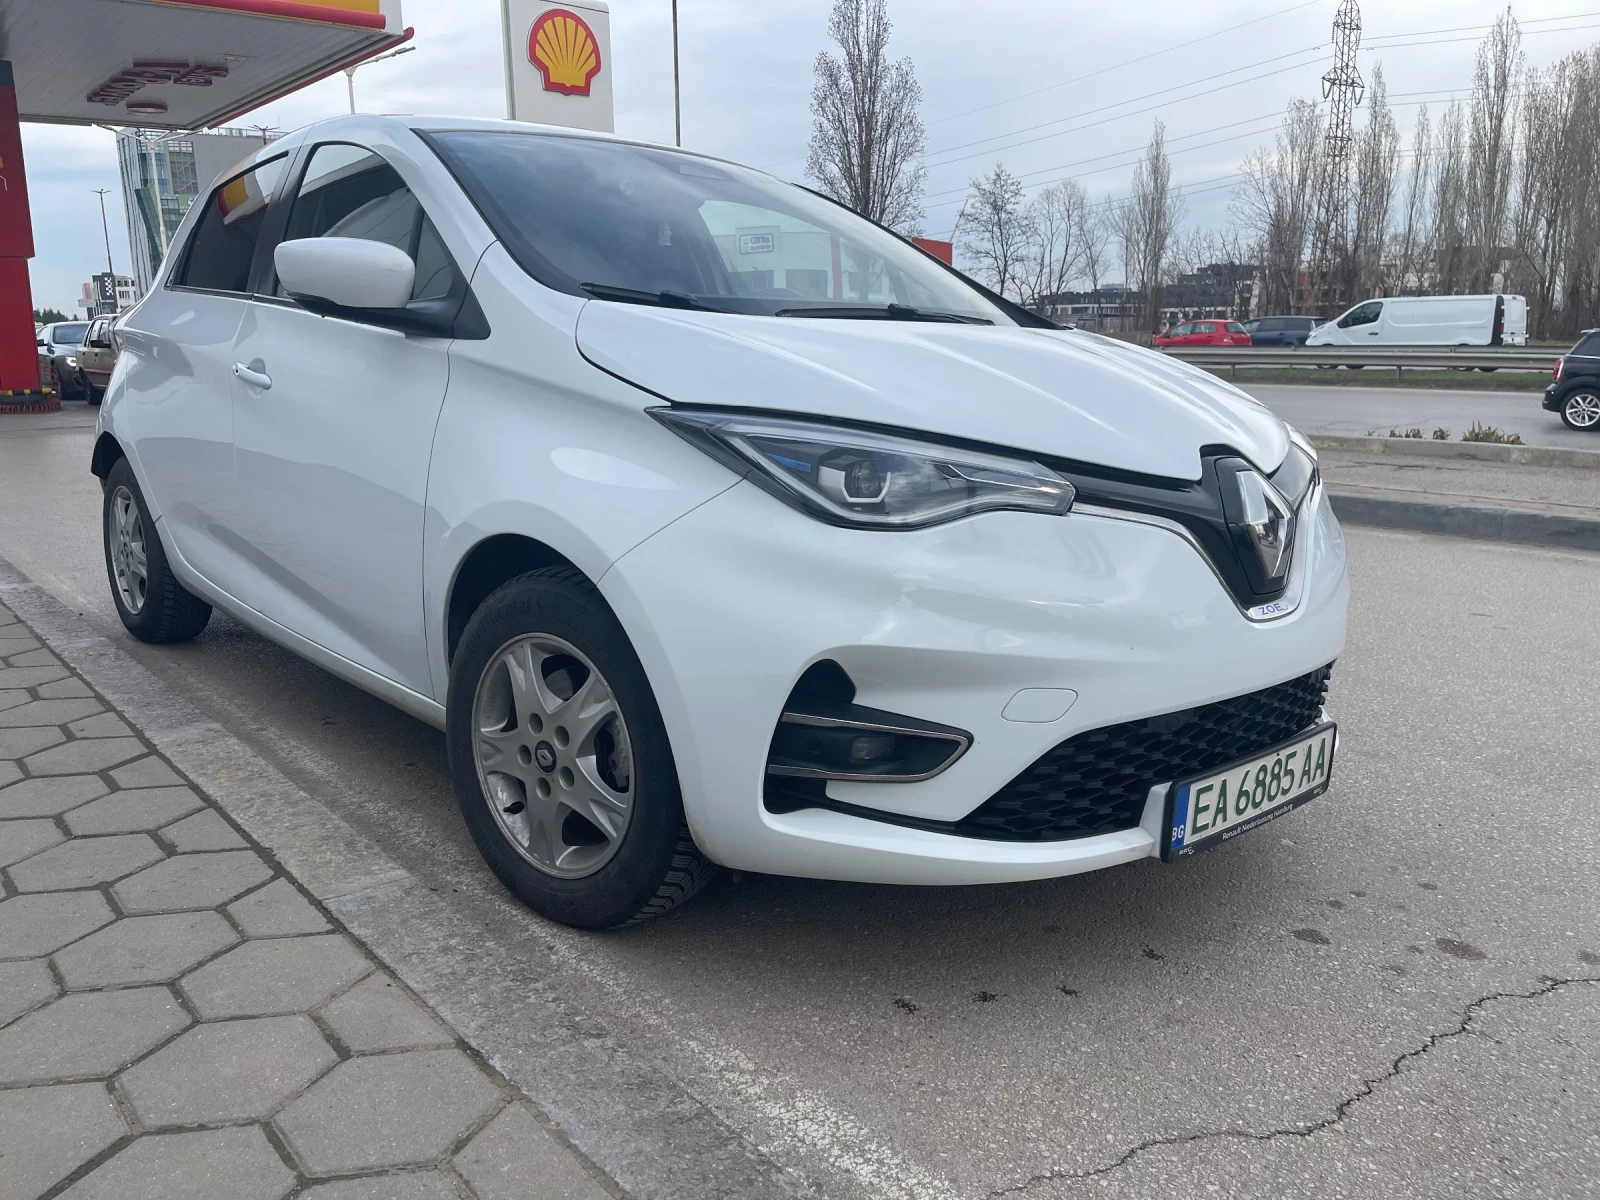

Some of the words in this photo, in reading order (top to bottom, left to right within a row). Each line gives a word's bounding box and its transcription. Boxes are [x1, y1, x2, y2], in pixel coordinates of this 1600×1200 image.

[1258, 603, 1284, 615] ZOE
[1235, 750, 1297, 816] 6885
[1298, 737, 1326, 789] AA
[1171, 824, 1184, 841] BG
[1222, 827, 1242, 840] Renault
